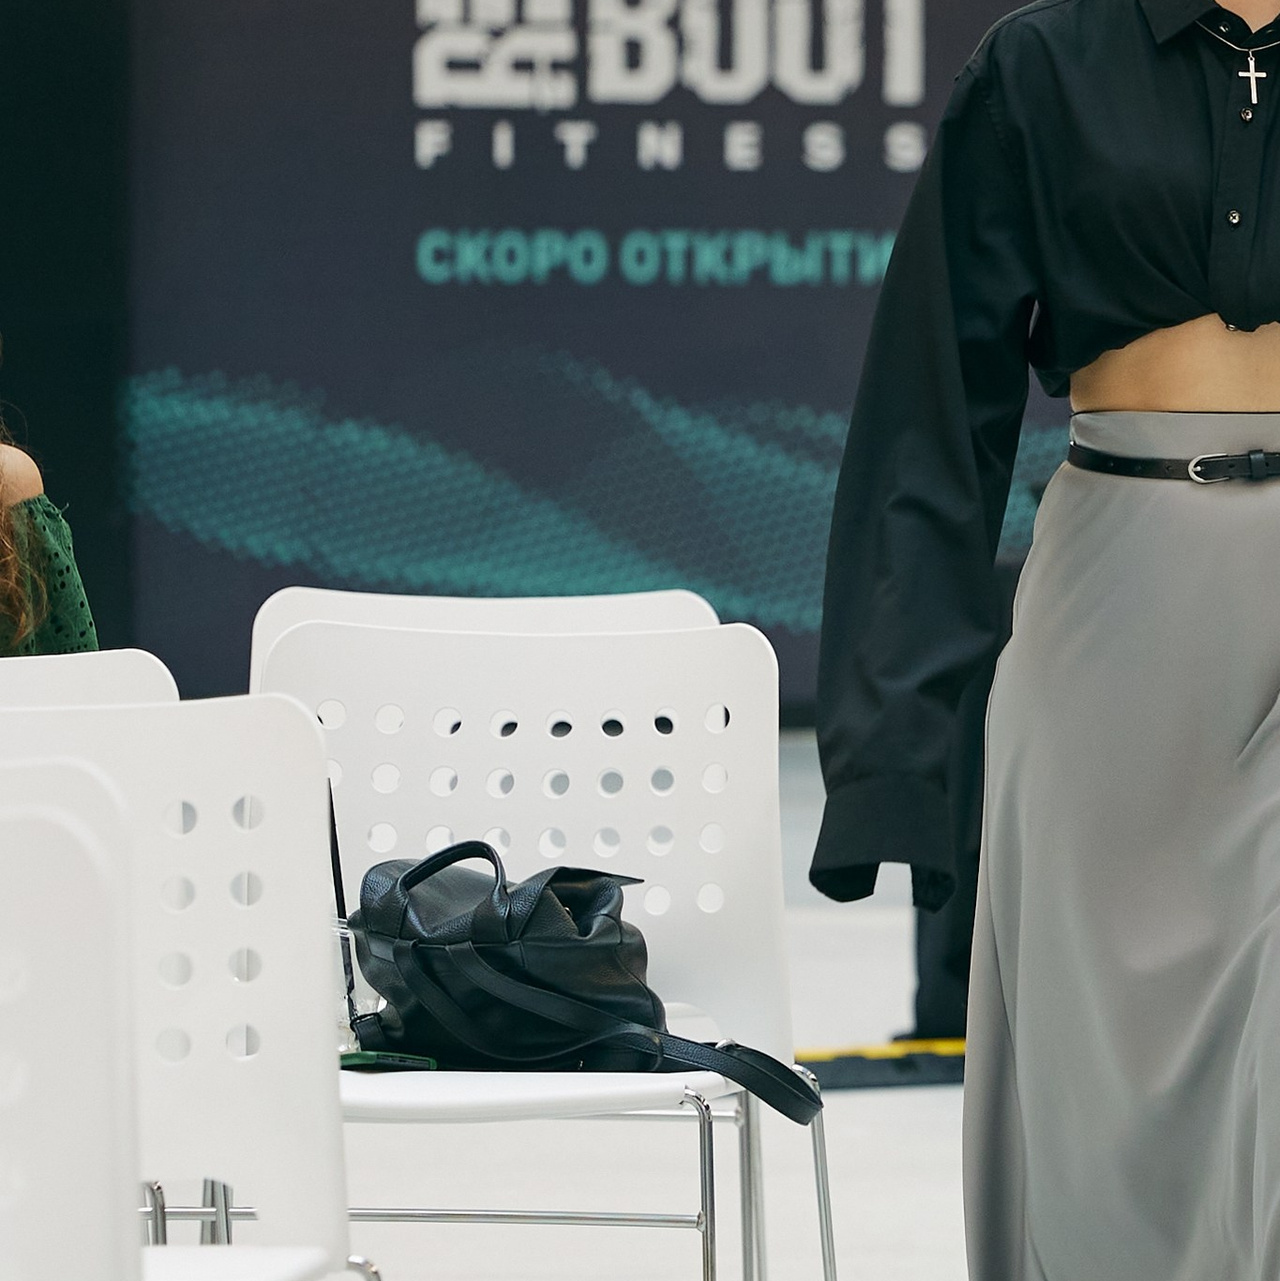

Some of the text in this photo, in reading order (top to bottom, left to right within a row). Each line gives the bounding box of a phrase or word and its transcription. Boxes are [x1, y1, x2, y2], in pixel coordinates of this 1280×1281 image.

[414, 120, 926, 171] FITNESS
[415, 229, 897, 285] СКОРО ОТКРЫТИ
